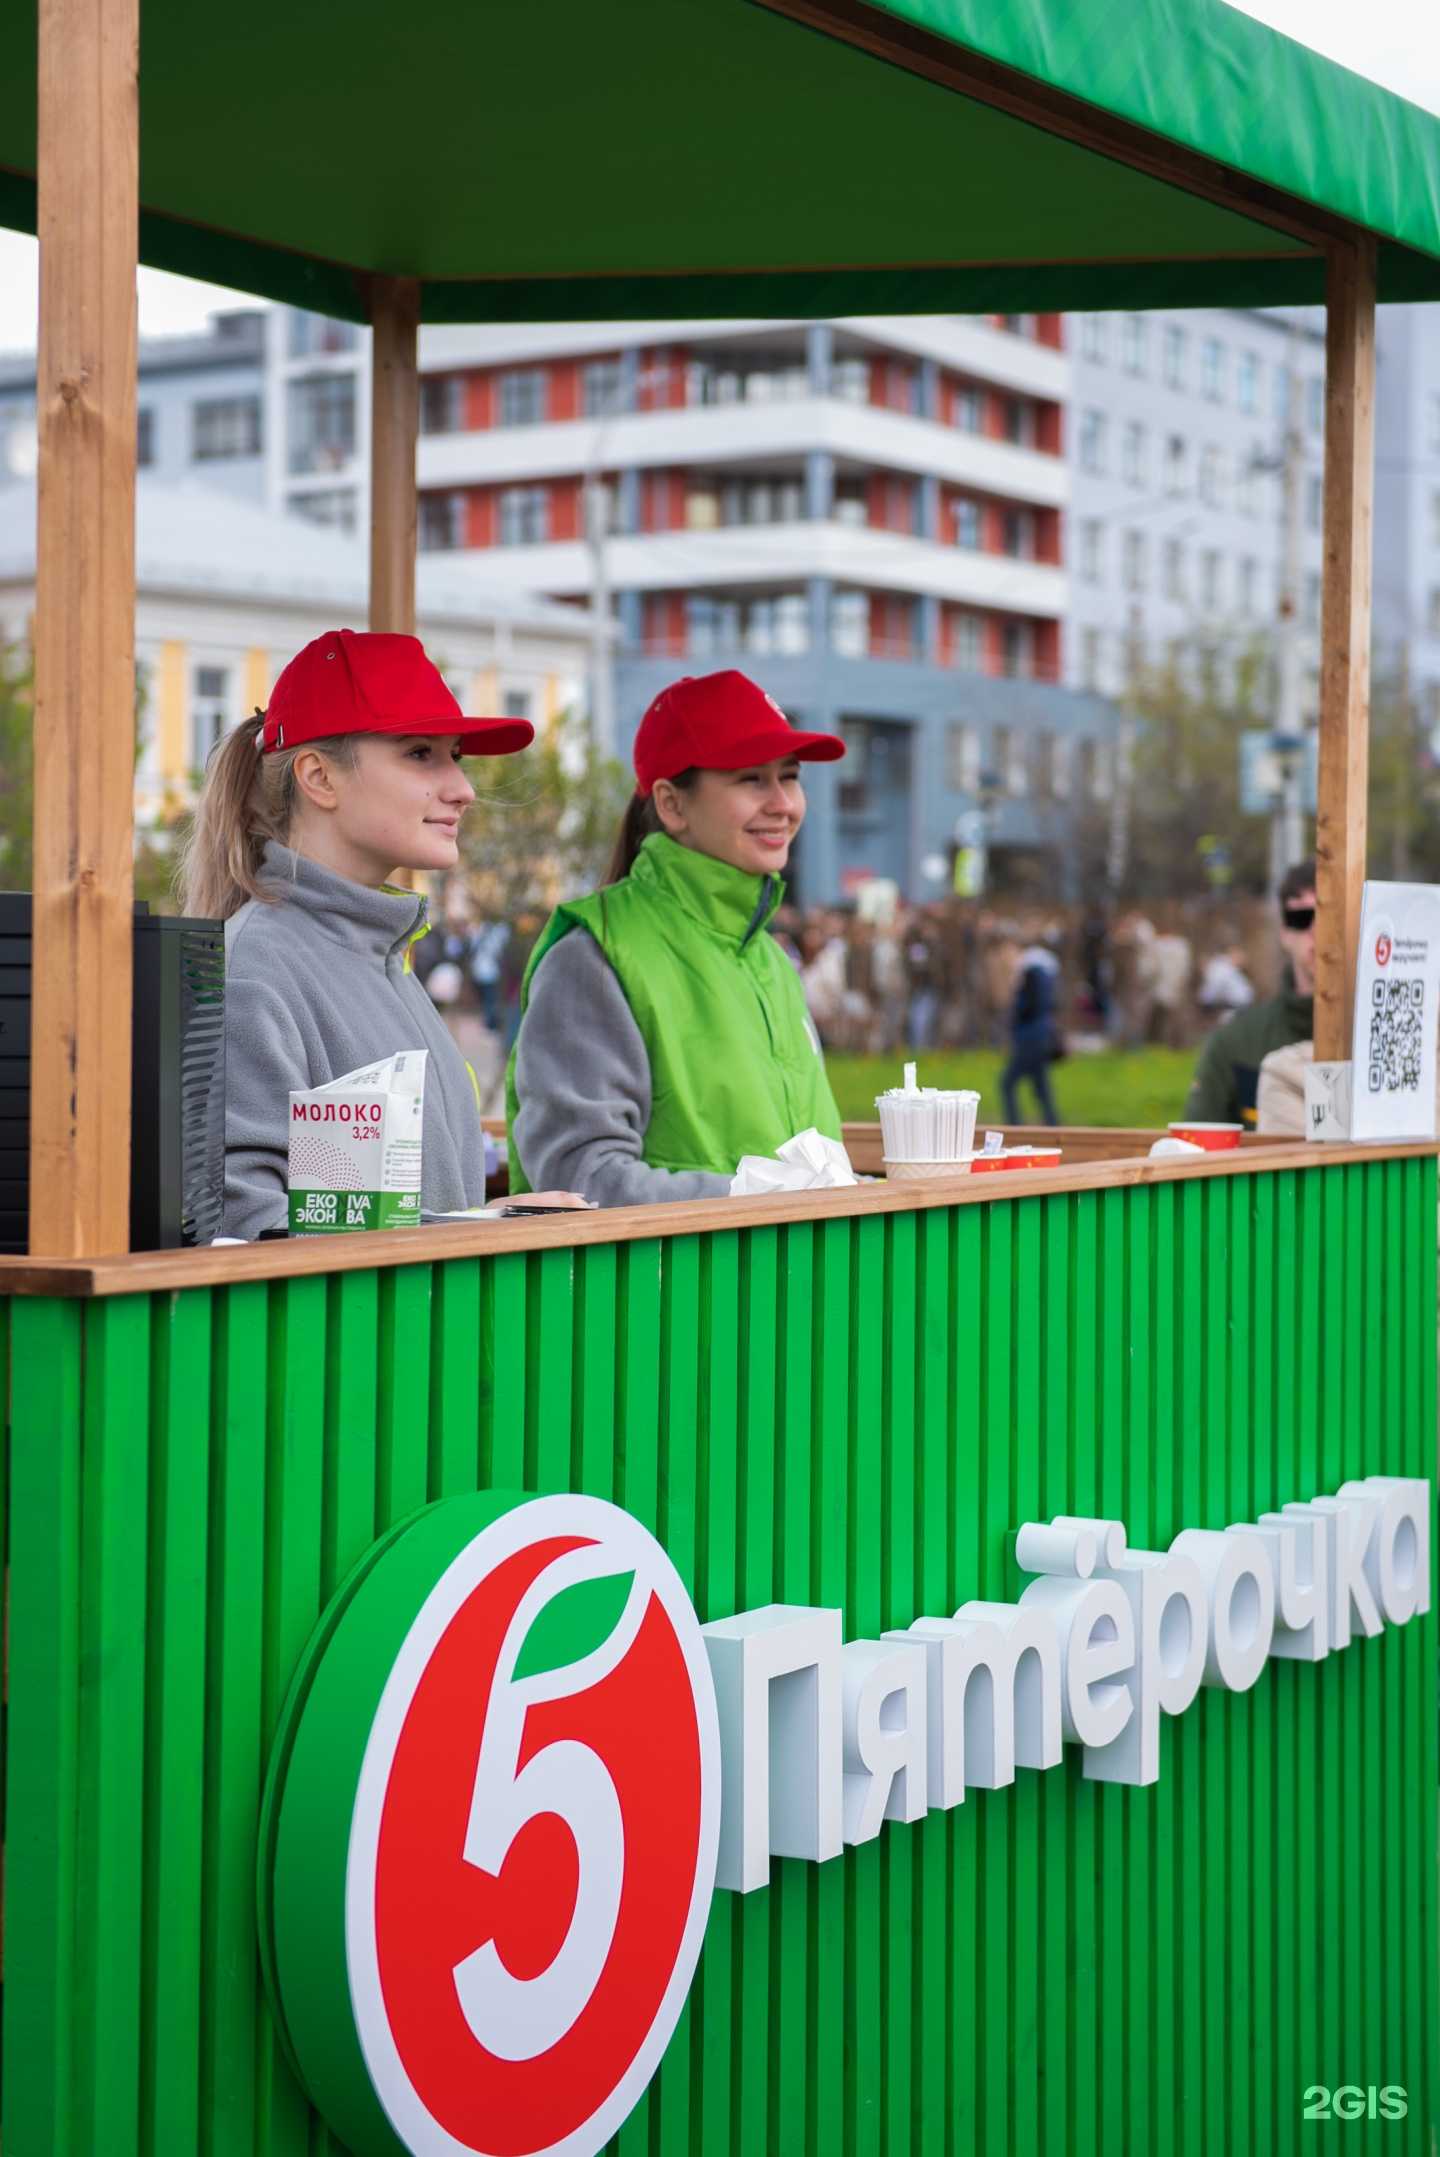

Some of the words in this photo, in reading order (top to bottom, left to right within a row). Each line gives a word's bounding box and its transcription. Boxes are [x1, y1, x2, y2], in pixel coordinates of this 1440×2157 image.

[293, 1104, 382, 1121] МОЛОКО
[352, 1127, 380, 1141] 3,2%
[703, 1476, 1430, 1893] Пятёрочка
[452, 1543, 652, 2062] 5
